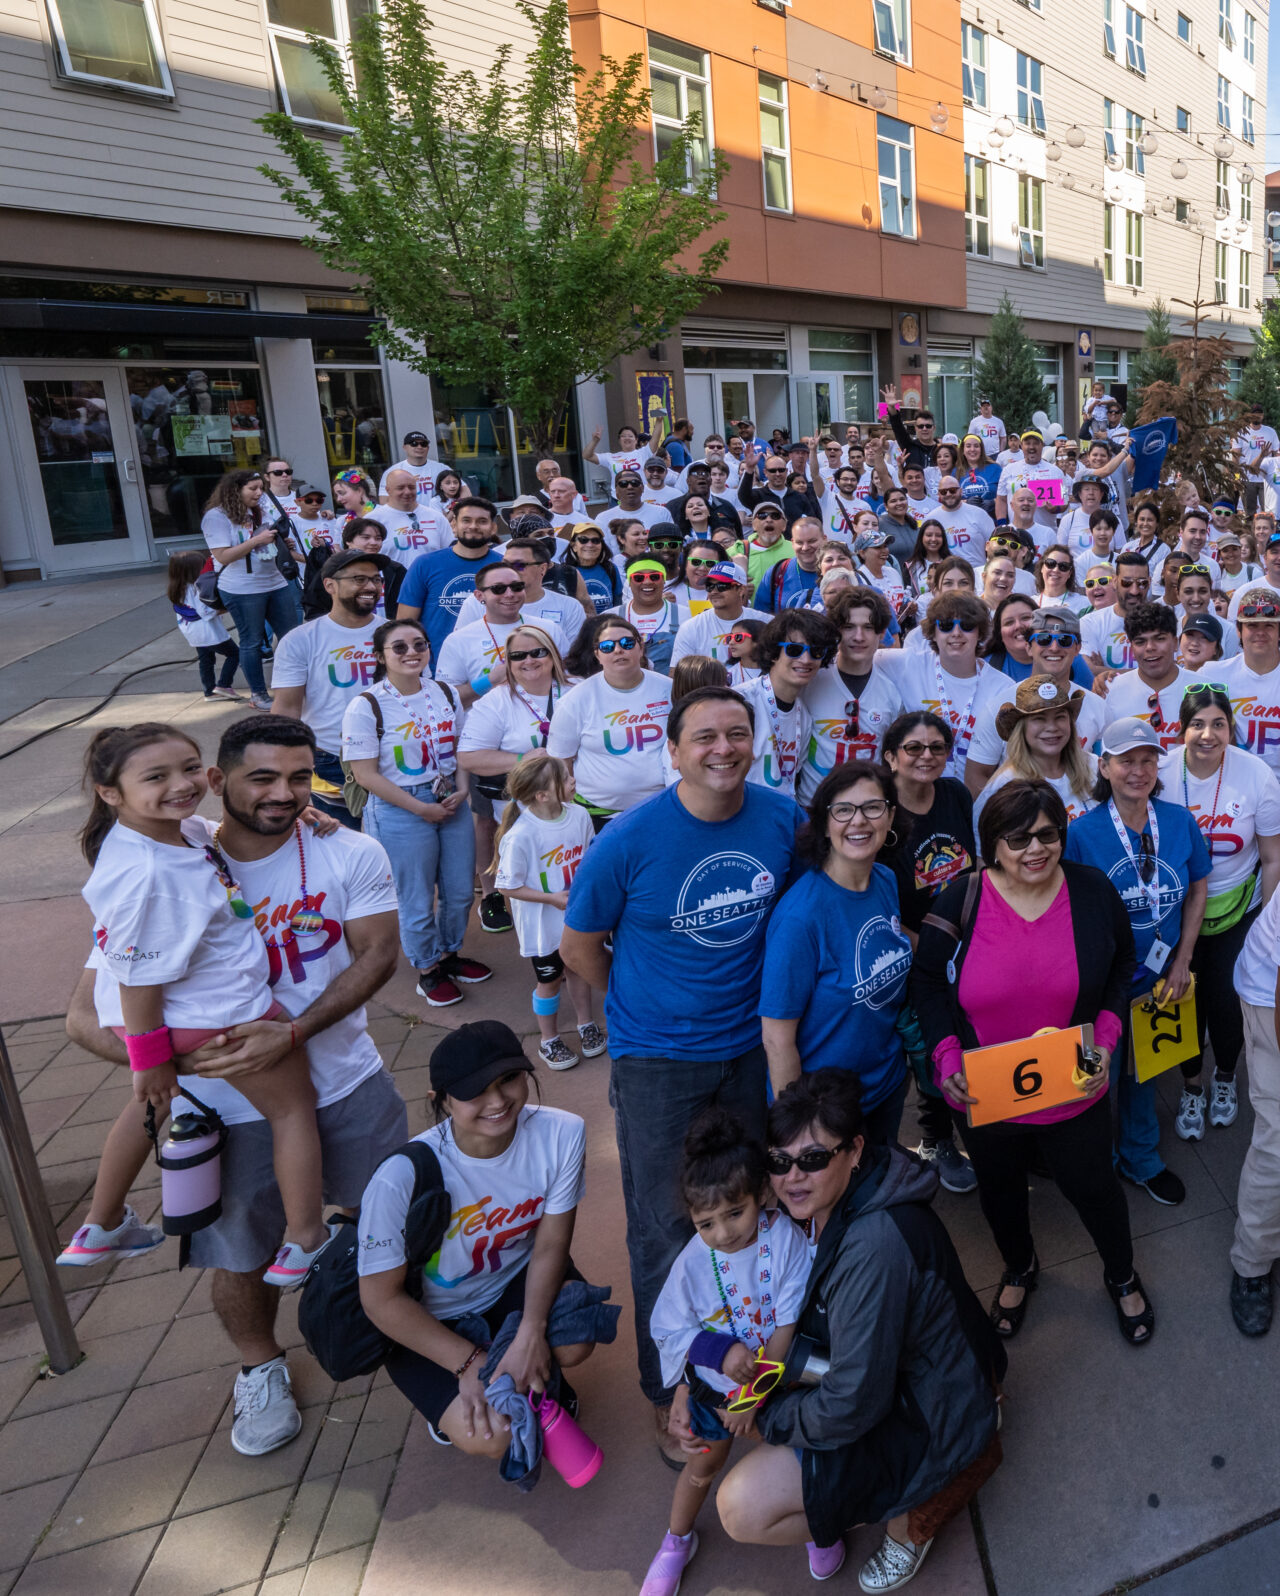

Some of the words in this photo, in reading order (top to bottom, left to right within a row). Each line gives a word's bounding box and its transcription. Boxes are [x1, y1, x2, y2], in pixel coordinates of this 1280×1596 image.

[980, 429, 998, 439] UP
[1036, 486, 1056, 500] 21
[394, 536, 429, 551] UP
[604, 709, 653, 727] Team
[603, 724, 663, 756] UP
[540, 843, 583, 868] Team
[696, 868, 709, 882] DAY
[711, 862, 720, 871] OF
[722, 861, 752, 873] SERVICE
[108, 951, 161, 962] COMCAST
[1150, 1003, 1184, 1055] 22
[1012, 1058, 1044, 1095] 6
[446, 1195, 545, 1240] Team
